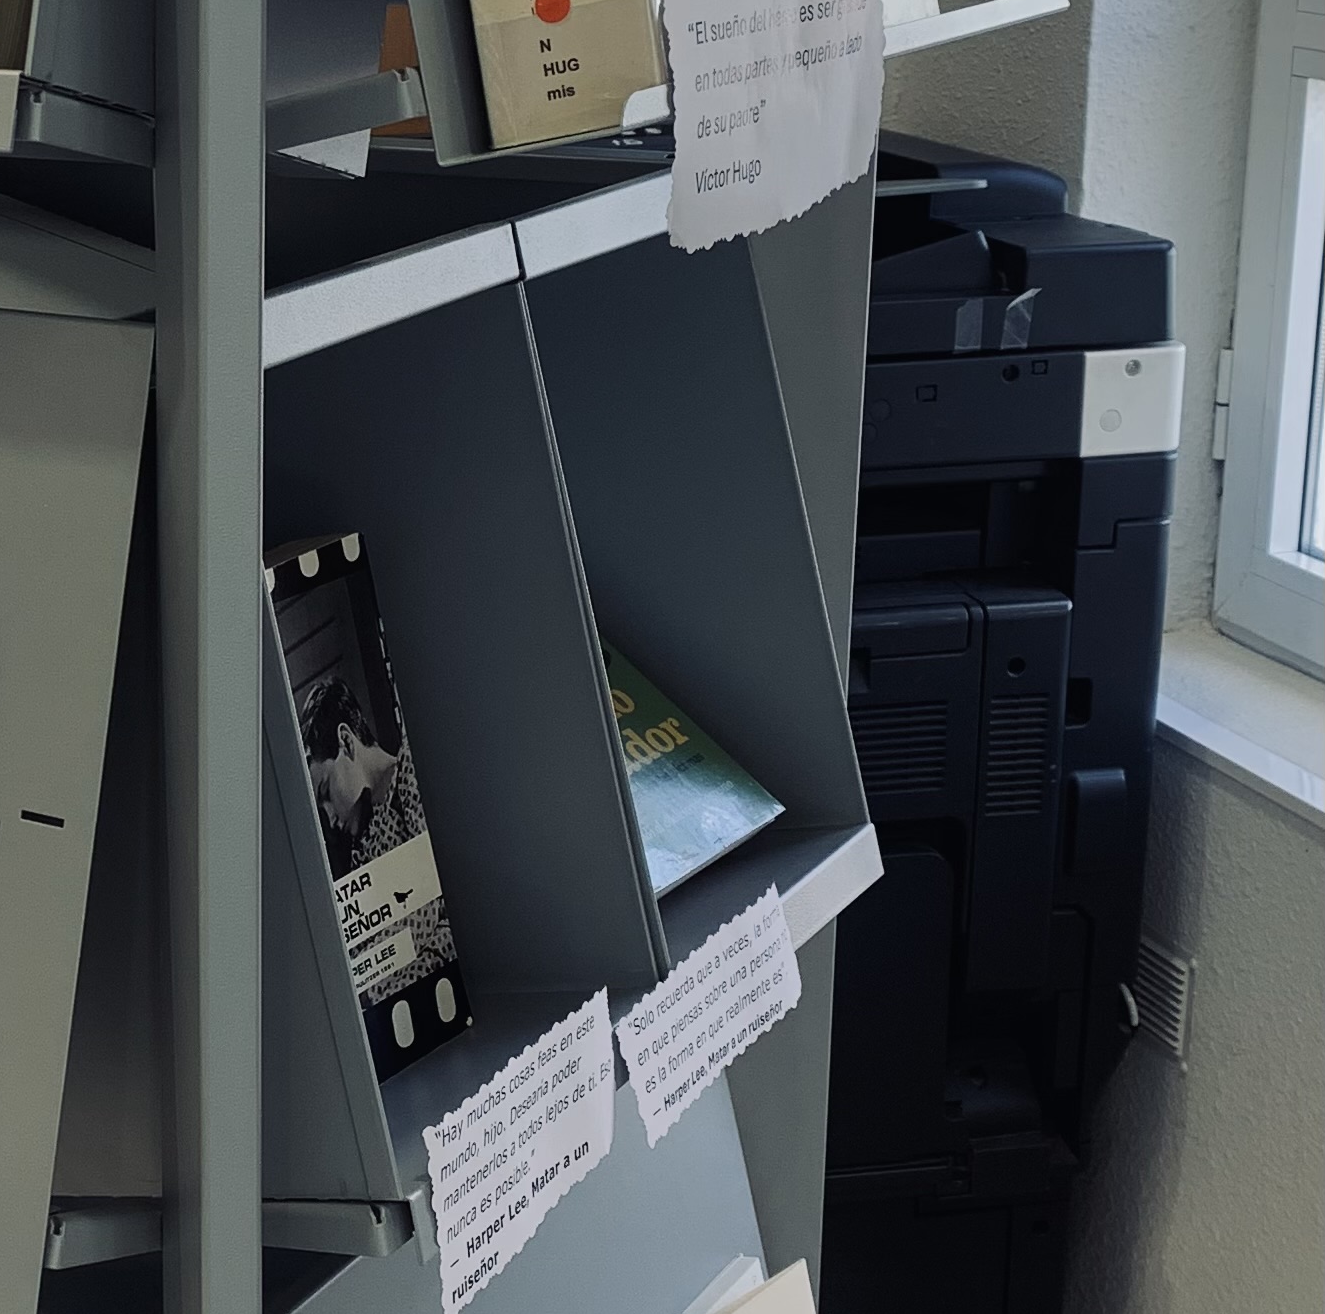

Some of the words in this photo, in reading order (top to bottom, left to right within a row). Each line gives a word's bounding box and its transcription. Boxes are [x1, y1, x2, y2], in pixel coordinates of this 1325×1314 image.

[540, 39, 552, 54] N
[543, 58, 580, 77] HUG
[547, 84, 576, 102] mis
[696, 167, 730, 193] Víctor
[732, 159, 761, 185] Hugo
[335, 873, 372, 903] ATAR
[344, 903, 392, 943] SEÑOR
[466, 1214, 506, 1259] Harper
[509, 1196, 530, 1222] Lee,
[531, 1162, 562, 1198] Matar
[563, 1154, 570, 1169] a
[574, 1141, 590, 1163] un
[452, 1251, 500, 1304] ruiseñor
